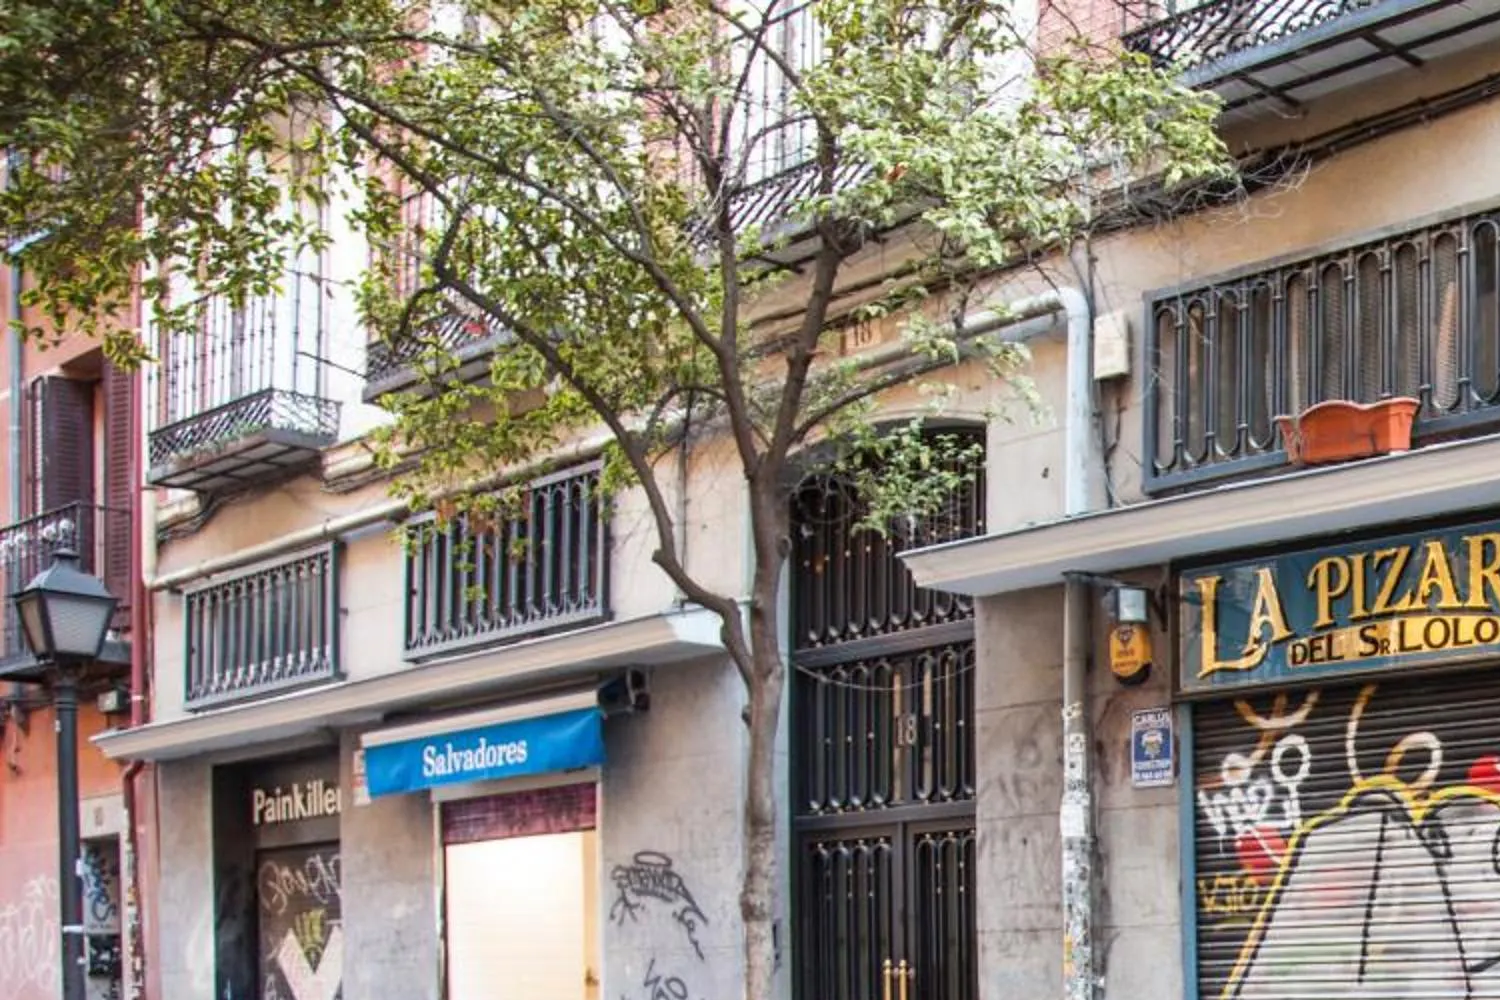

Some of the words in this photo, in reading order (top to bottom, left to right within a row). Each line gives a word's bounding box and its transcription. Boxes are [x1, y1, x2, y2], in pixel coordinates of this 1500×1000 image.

[1194, 567, 1294, 678] LA
[1291, 632, 1344, 665] DEL
[1399, 617, 1500, 652] LOLO
[423, 737, 528, 777] Salvadores
